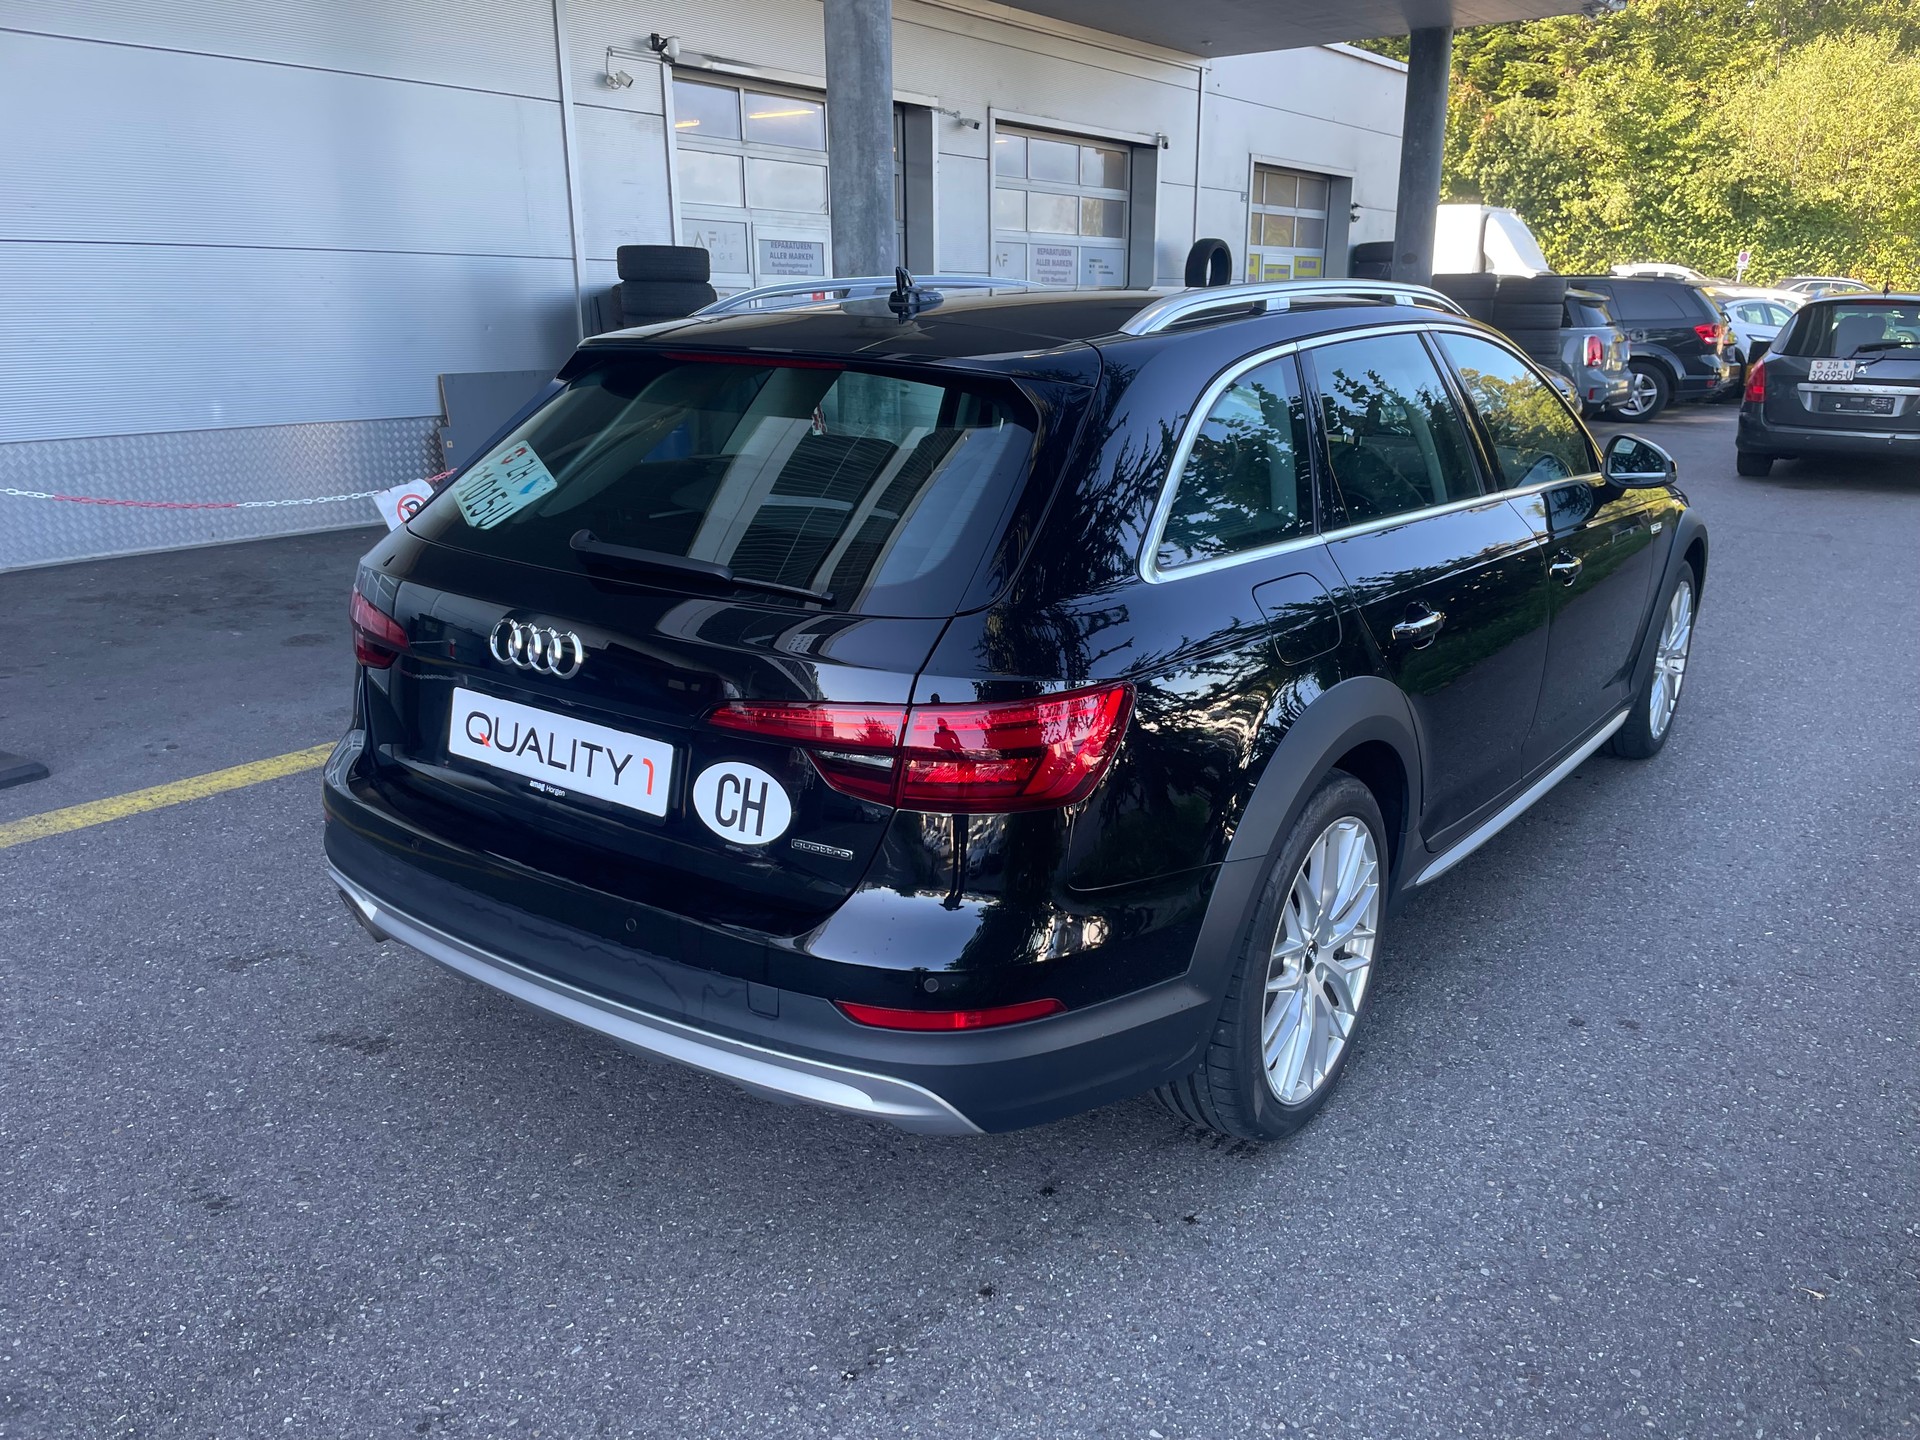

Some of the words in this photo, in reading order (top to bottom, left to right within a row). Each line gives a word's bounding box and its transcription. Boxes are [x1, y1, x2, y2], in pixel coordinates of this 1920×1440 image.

[770, 240, 812, 250] REPARATUREN
[769, 251, 788, 260] ALLER
[788, 252, 814, 261] MARKEN
[1037, 247, 1072, 257] REPARATUREN
[1035, 258, 1050, 266] ALLER
[1051, 259, 1073, 267] MARKEN
[1827, 361, 1839, 369] ZH
[506, 457, 540, 485] ZH
[529, 780, 546, 792] amag
[546, 785, 566, 797] Horgen
[714, 772, 769, 837] CH
[793, 840, 850, 858] quattro
